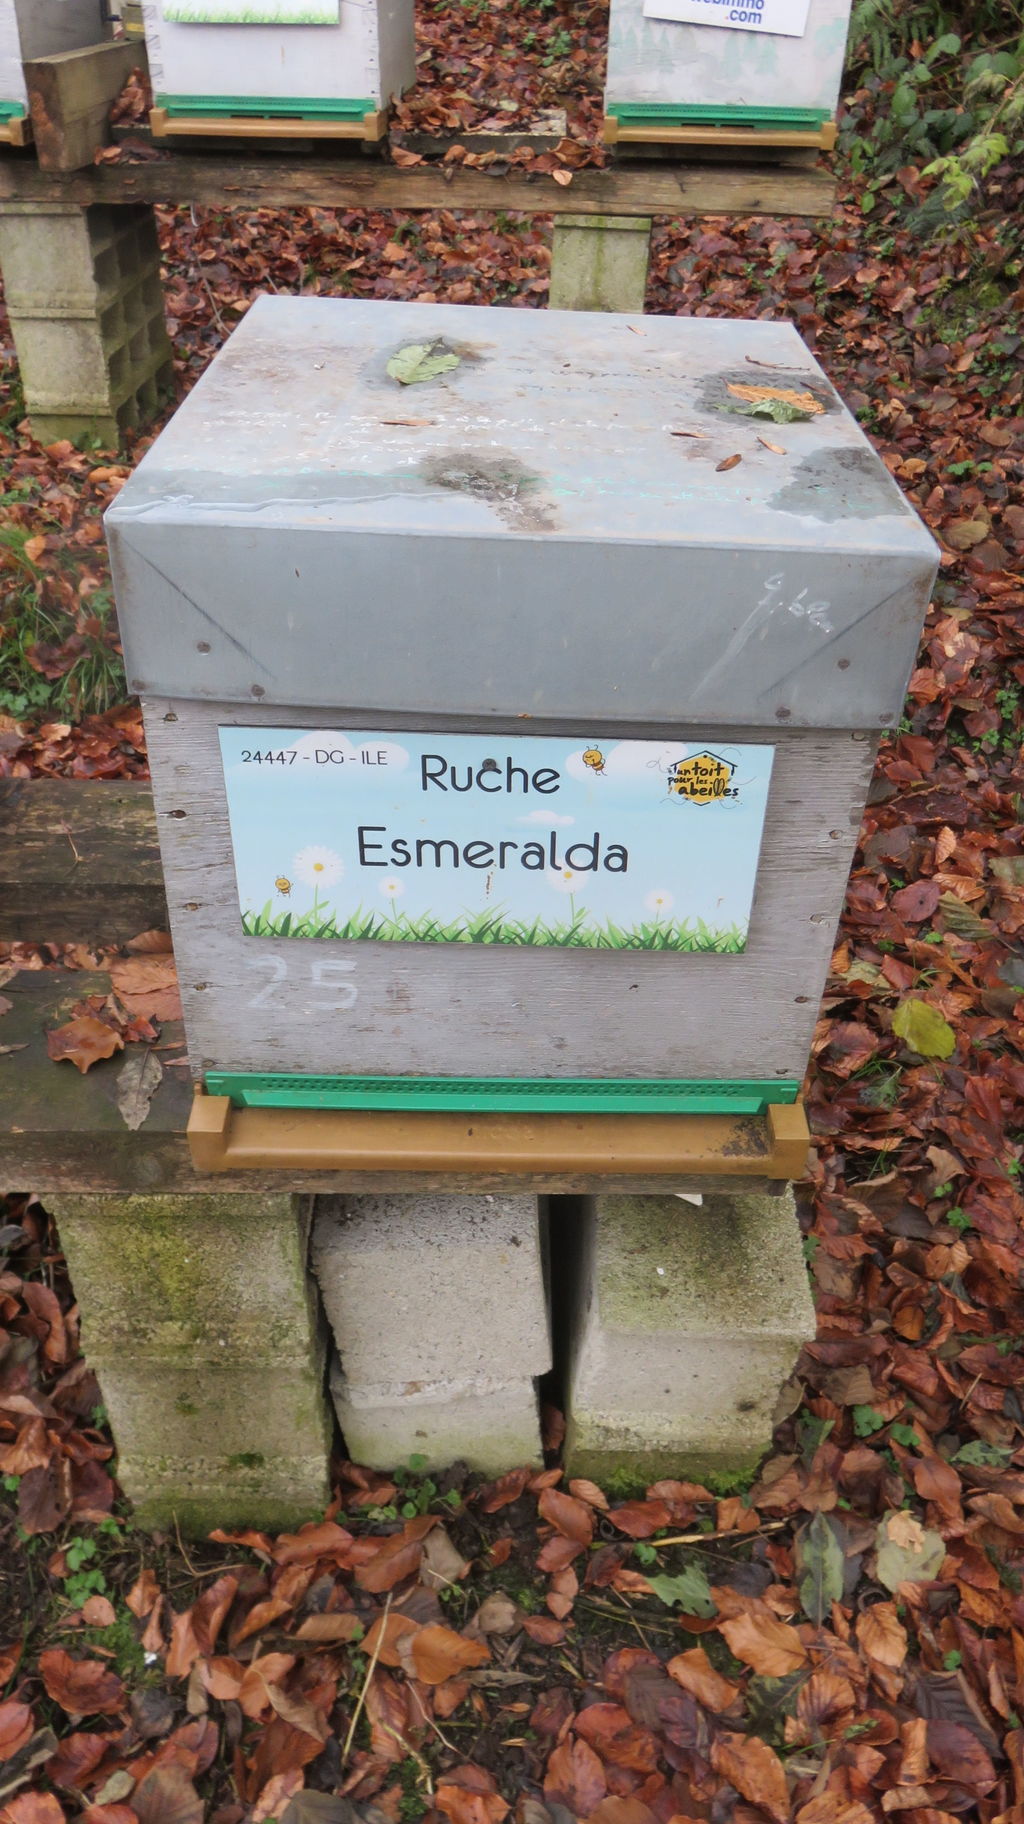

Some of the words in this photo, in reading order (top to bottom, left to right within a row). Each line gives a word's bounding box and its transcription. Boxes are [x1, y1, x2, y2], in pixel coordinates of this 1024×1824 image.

[724, 10, 762, 24] .com
[241, 751, 298, 765] 24447
[315, 750, 344, 764] DG
[361, 751, 388, 765] ILE
[421, 754, 561, 794] Ruche
[677, 768, 691, 776] un
[692, 761, 725, 776] toit
[667, 776, 693, 786] pour
[696, 776, 708, 785] les
[678, 778, 739, 797] abeilles
[357, 825, 629, 873] Esmeralda
[244, 955, 358, 1009] 25
